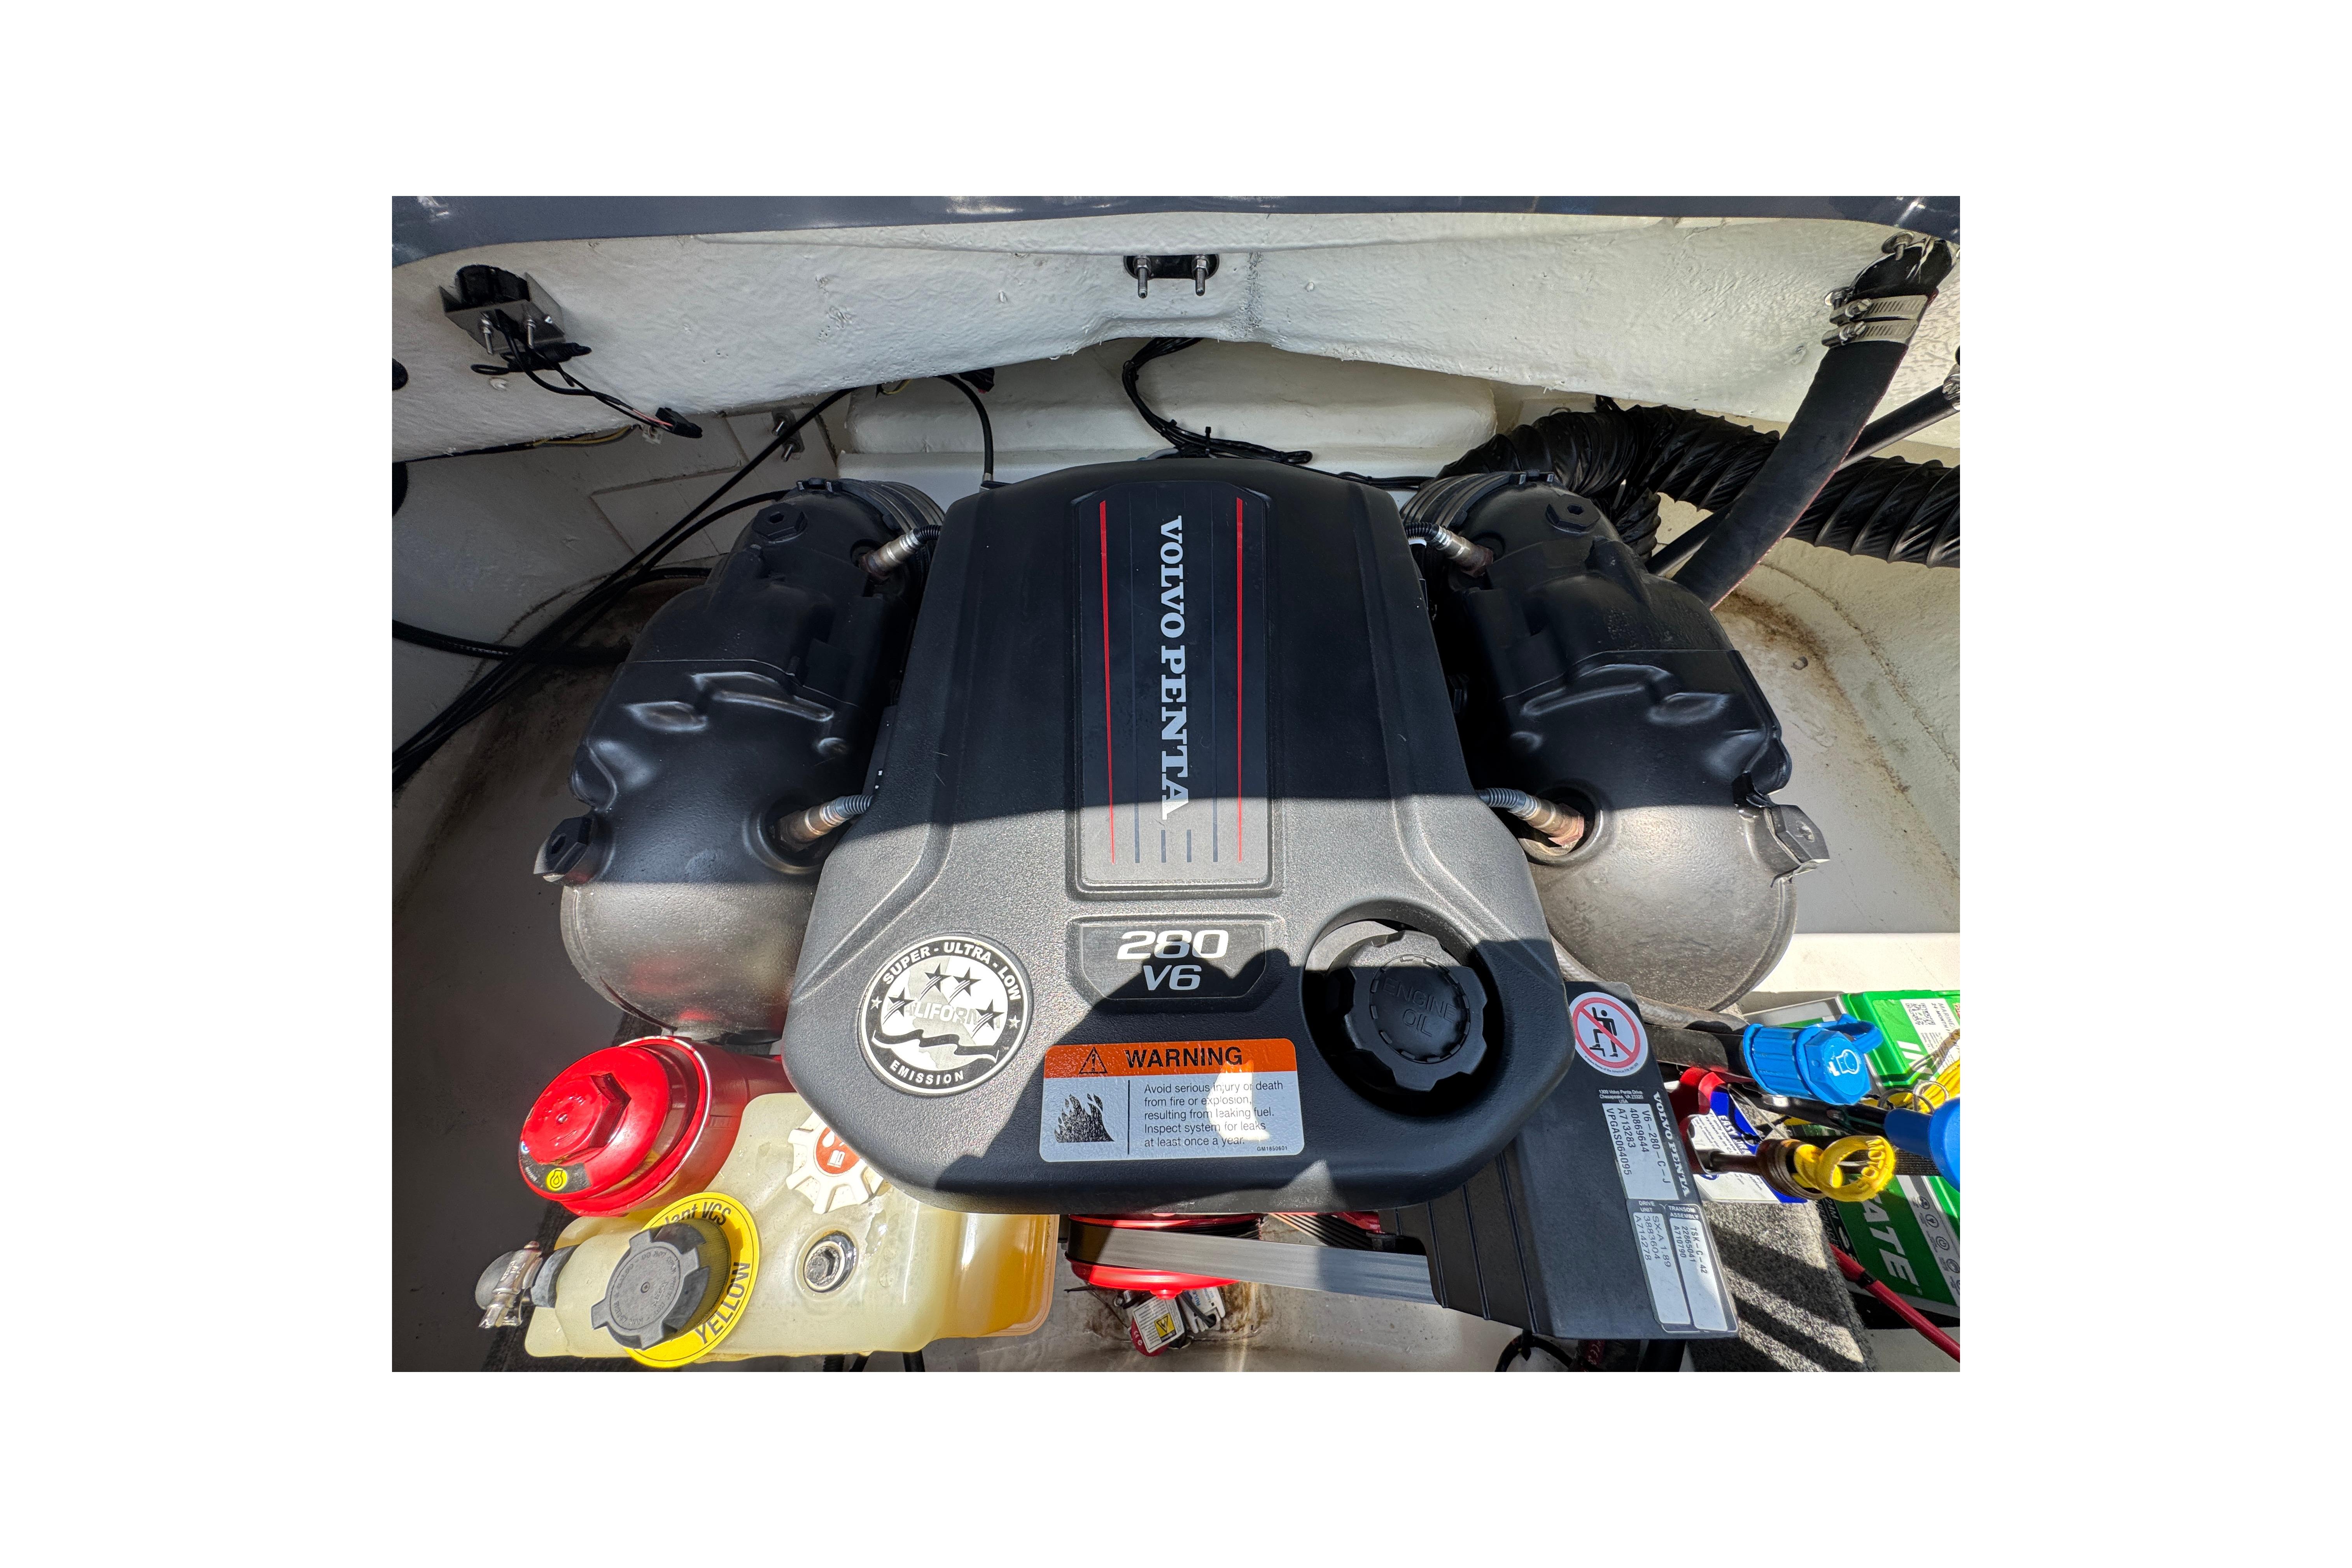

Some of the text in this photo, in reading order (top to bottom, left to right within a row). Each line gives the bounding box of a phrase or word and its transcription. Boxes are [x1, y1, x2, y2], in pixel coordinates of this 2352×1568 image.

[1160, 516, 1188, 820] VOLVO PENTA
[1116, 929, 1228, 959] 280
[883, 948, 930, 985] SUPER
[944, 942, 992, 962] ULTRA
[998, 966, 1022, 1000] LOW
[1143, 965, 1202, 991] V6
[1382, 977, 1458, 1023] ENGINE
[1402, 1008, 1432, 1037] OIL
[889, 1060, 964, 1085] EMISSION
[1125, 1047, 1242, 1069] WARNING
[1144, 1083, 1171, 1094] Avoid
[1175, 1083, 1210, 1093] serious
[1213, 1082, 1240, 1094] injury
[1256, 1080, 1283, 1090] death
[1144, 1097, 1166, 1107] from
[1170, 1096, 1185, 1106] fire
[1201, 1096, 1251, 1107] explosion,
[1144, 1107, 1274, 1121] resulting from leaking fuel.
[1145, 1121, 1266, 1135] Inspect system for leaks
[1617, 1108, 1636, 1148] A713283
[1630, 1108, 1649, 1153] 40869644
[1717, 1115, 1739, 1136] EASY
[1144, 1138, 1154, 1147] at
[1158, 1137, 1181, 1147] least
[1185, 1138, 1209, 1146] once
[1222, 1137, 1244, 1147] year.
[1606, 1108, 1632, 1175] VPGAS064095
[1654, 1091, 1690, 1197] VOLVO PENTA
[665, 1202, 731, 1226] lant VCS
[1634, 1215, 1652, 1260] A714278
[1643, 1215, 1661, 1260] 3883604
[1652, 1216, 1671, 1267] SX-A 1.89
[1673, 1225, 1687, 1258] A710790
[1681, 1226, 1696, 1262] 22865041
[1862, 1195, 1920, 1286] ATE
[695, 1262, 751, 1344] YELLOW
